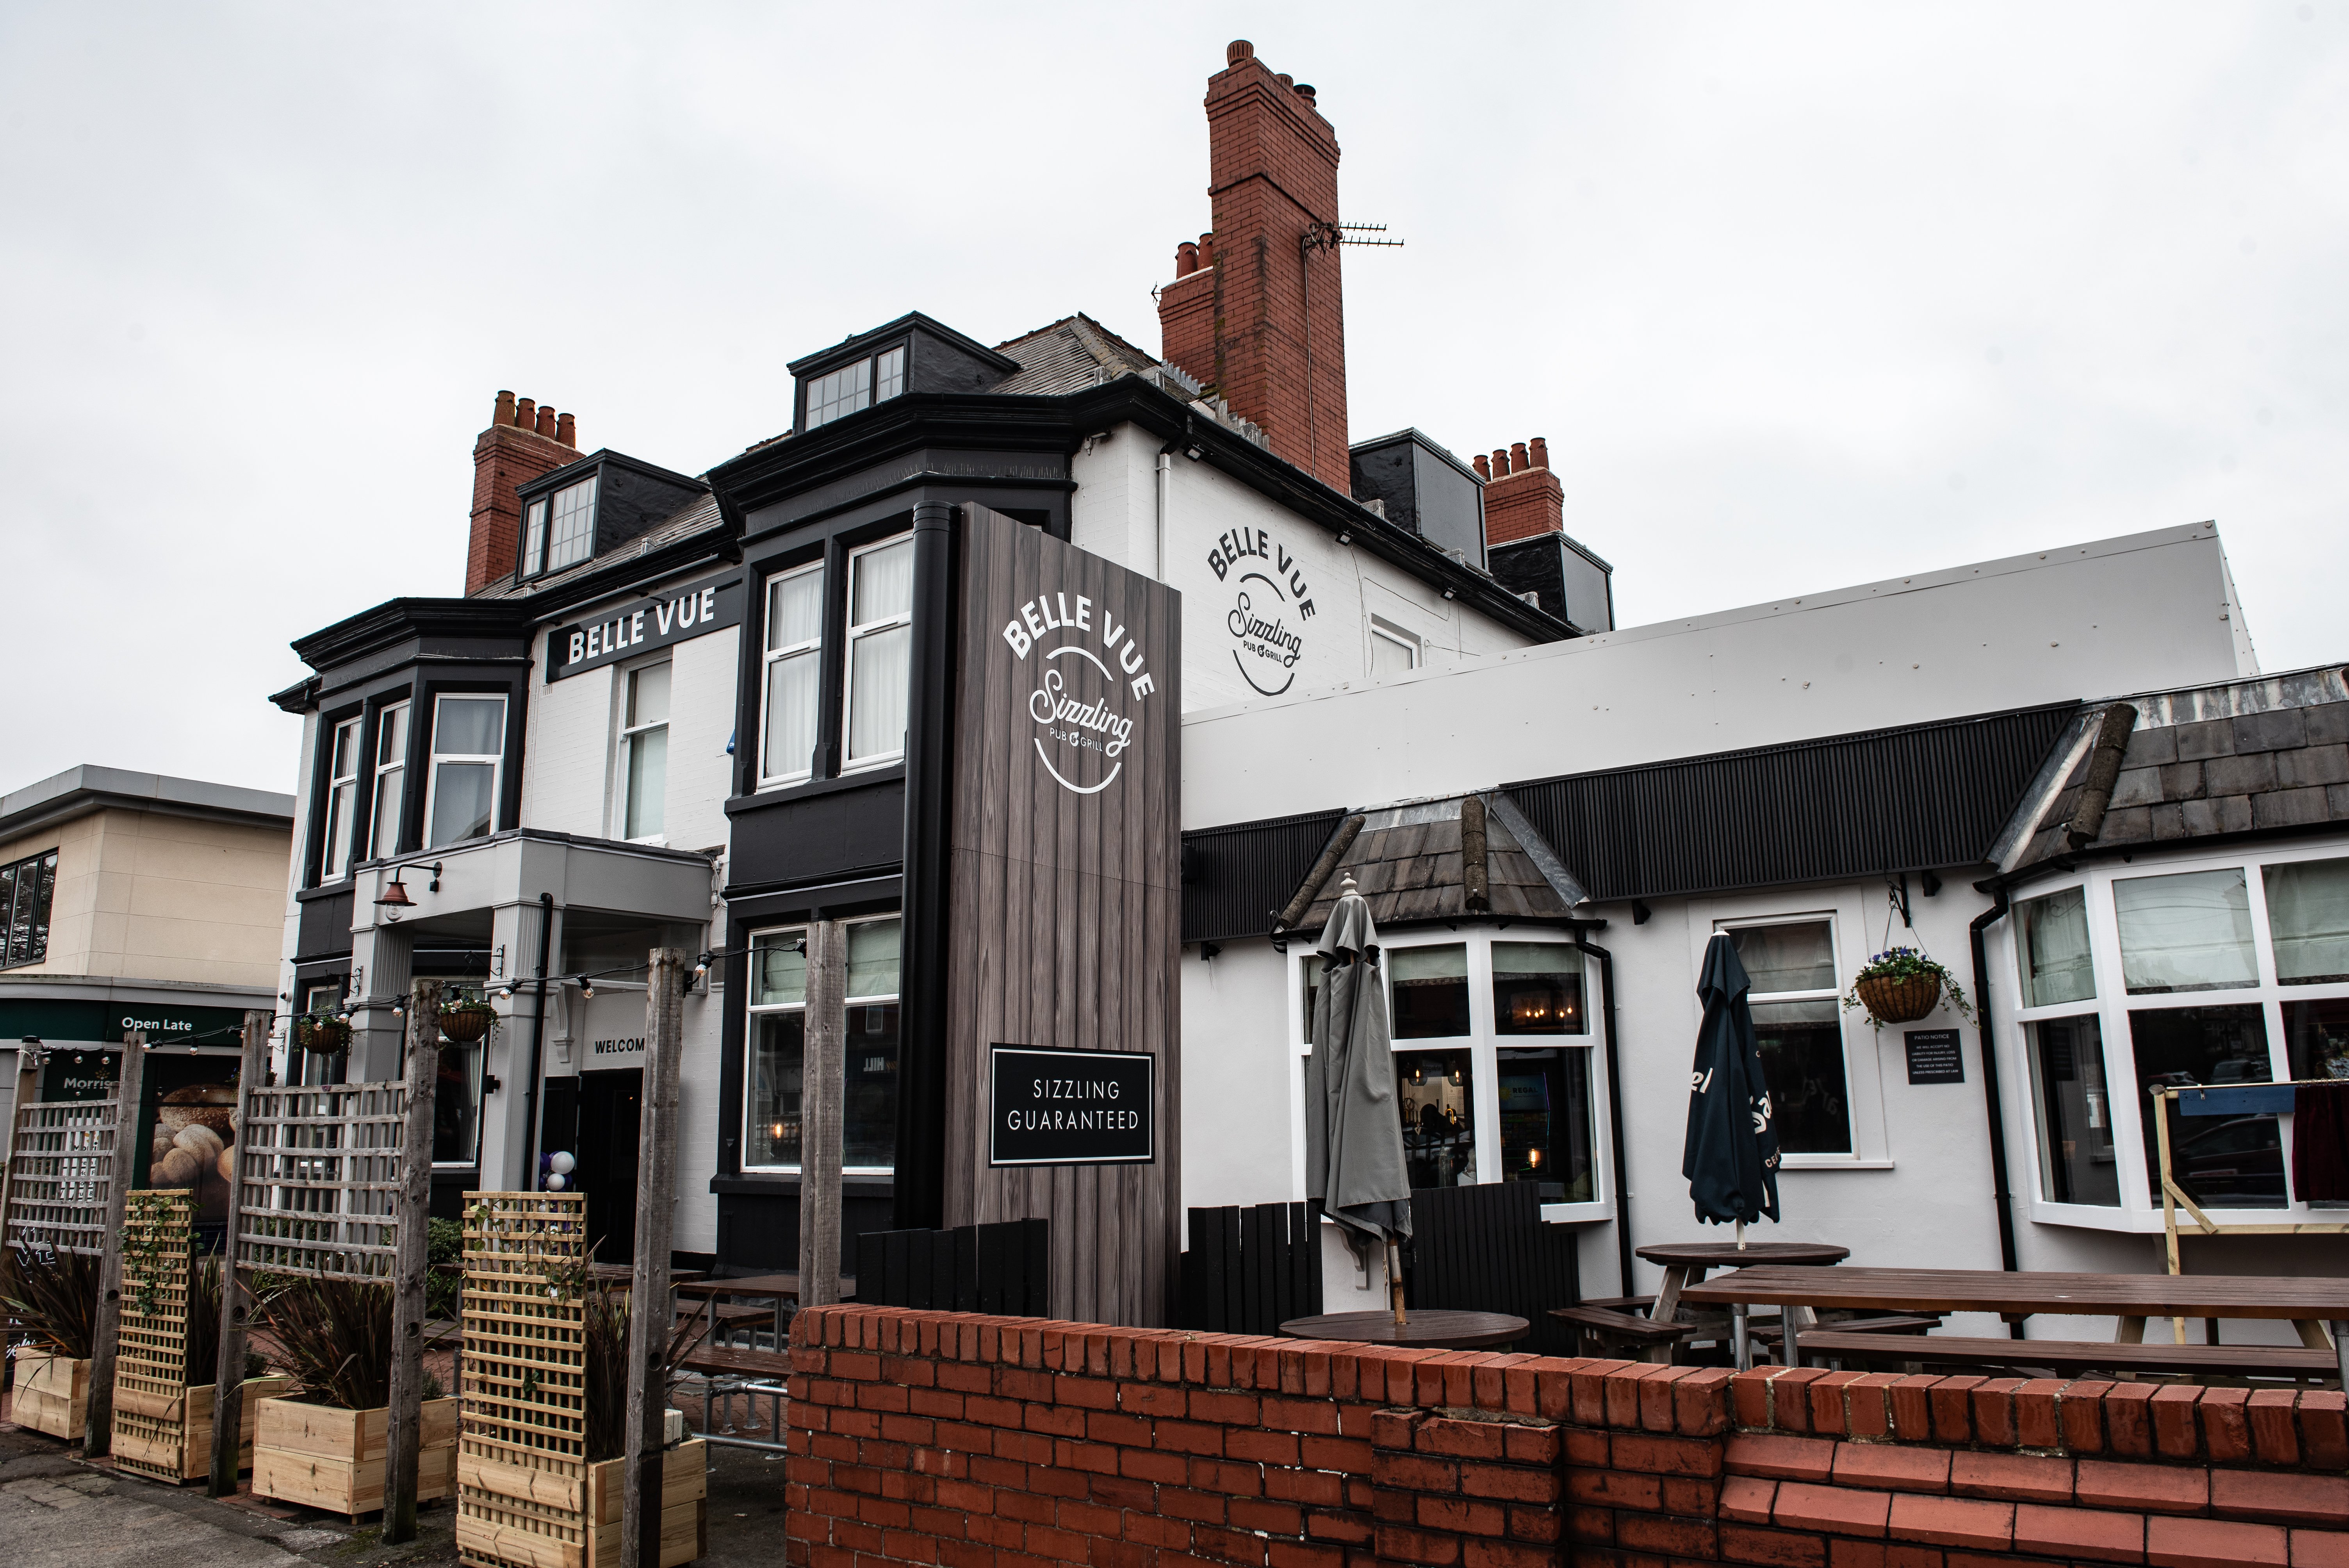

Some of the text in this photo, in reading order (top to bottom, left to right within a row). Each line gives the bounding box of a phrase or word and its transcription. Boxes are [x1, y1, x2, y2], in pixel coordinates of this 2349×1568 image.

[1207, 526, 1316, 622] BELLE VUE
[569, 586, 715, 665] BELLE VUE
[1228, 592, 1302, 668] Sizzling
[1002, 592, 1155, 702] BELLE VUE
[1243, 640, 1256, 652] PUB
[1265, 649, 1282, 663] GRILL
[1029, 669, 1133, 757] Sizzling
[1050, 727, 1067, 741] PUB
[1080, 736, 1103, 752] GRILL
[122, 1017, 192, 1031] Open Late
[595, 1037, 645, 1054] WELCOM
[64, 1076, 111, 1089] Morris
[1034, 1079, 1119, 1099] SIZZLING
[1008, 1110, 1138, 1130] GUARANTEED
